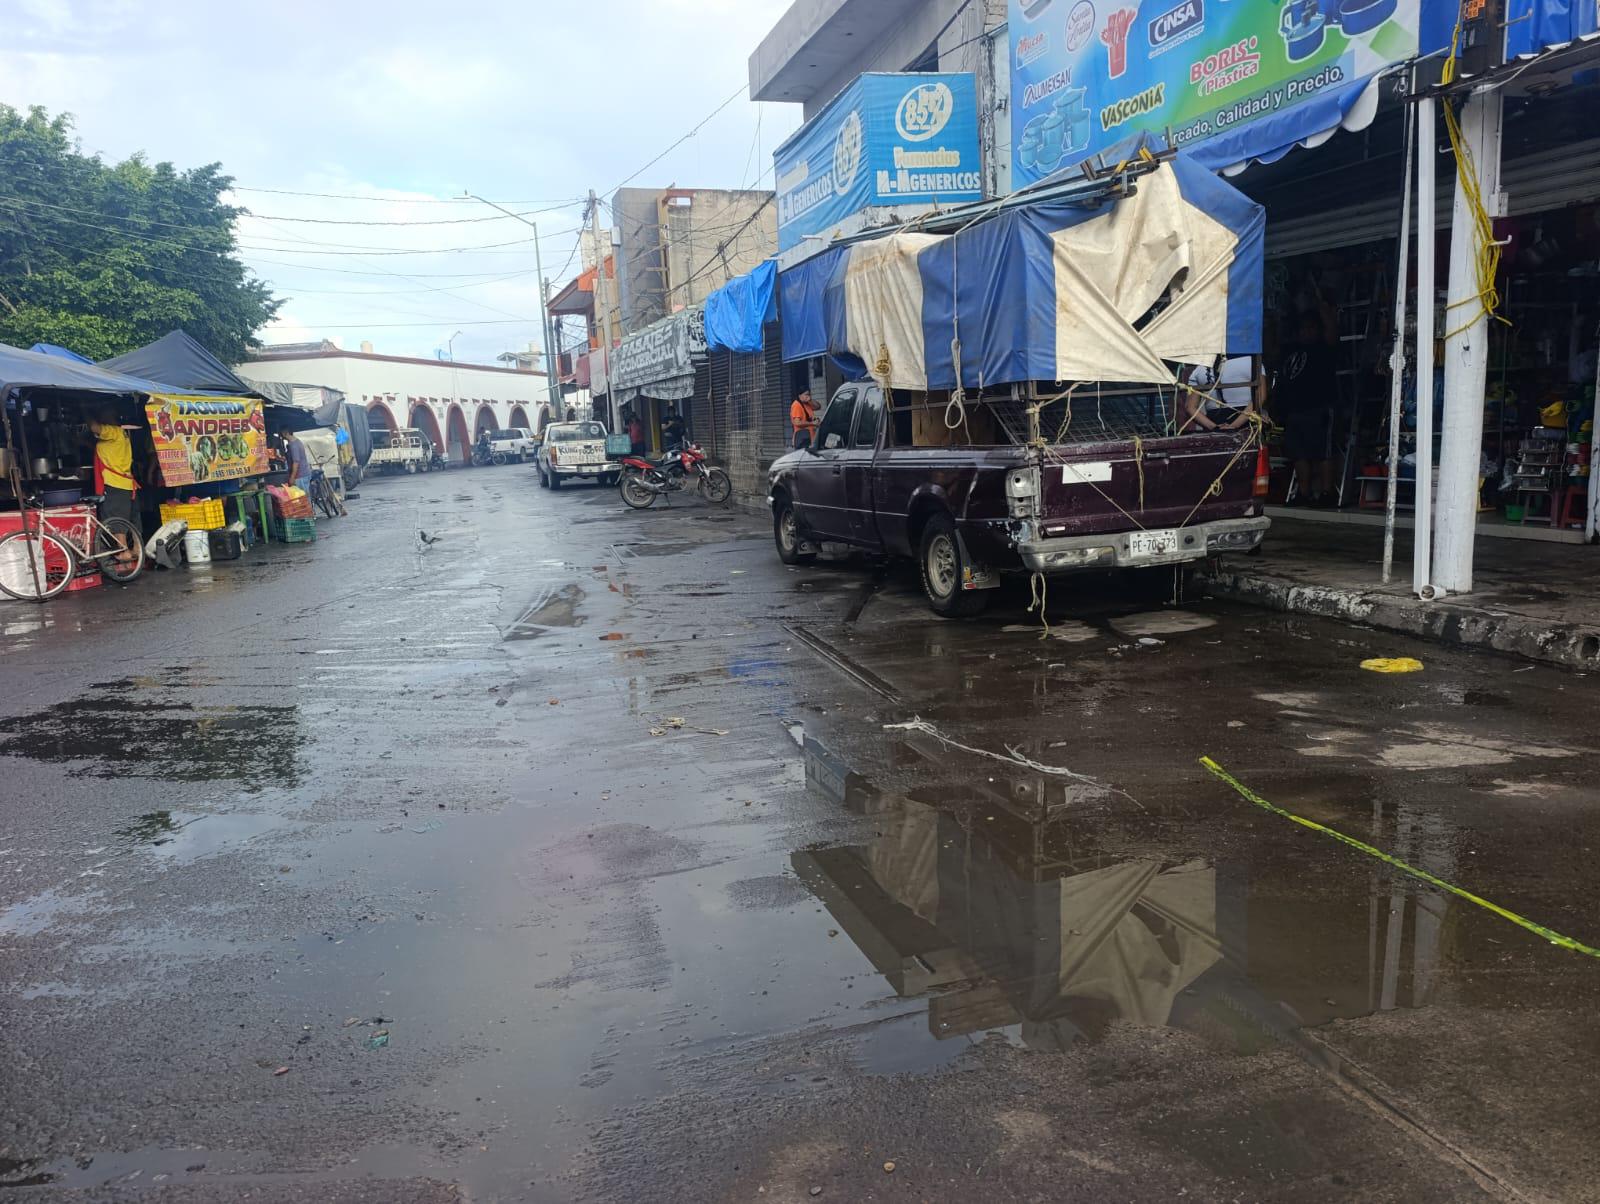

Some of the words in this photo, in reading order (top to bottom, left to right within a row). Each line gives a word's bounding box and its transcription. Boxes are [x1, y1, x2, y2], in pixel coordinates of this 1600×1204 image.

[1190, 40, 1248, 83] BORIS
[1215, 93, 1270, 128] Calidad
[1273, 91, 1284, 109] y
[173, 418, 251, 436] ANDRES
